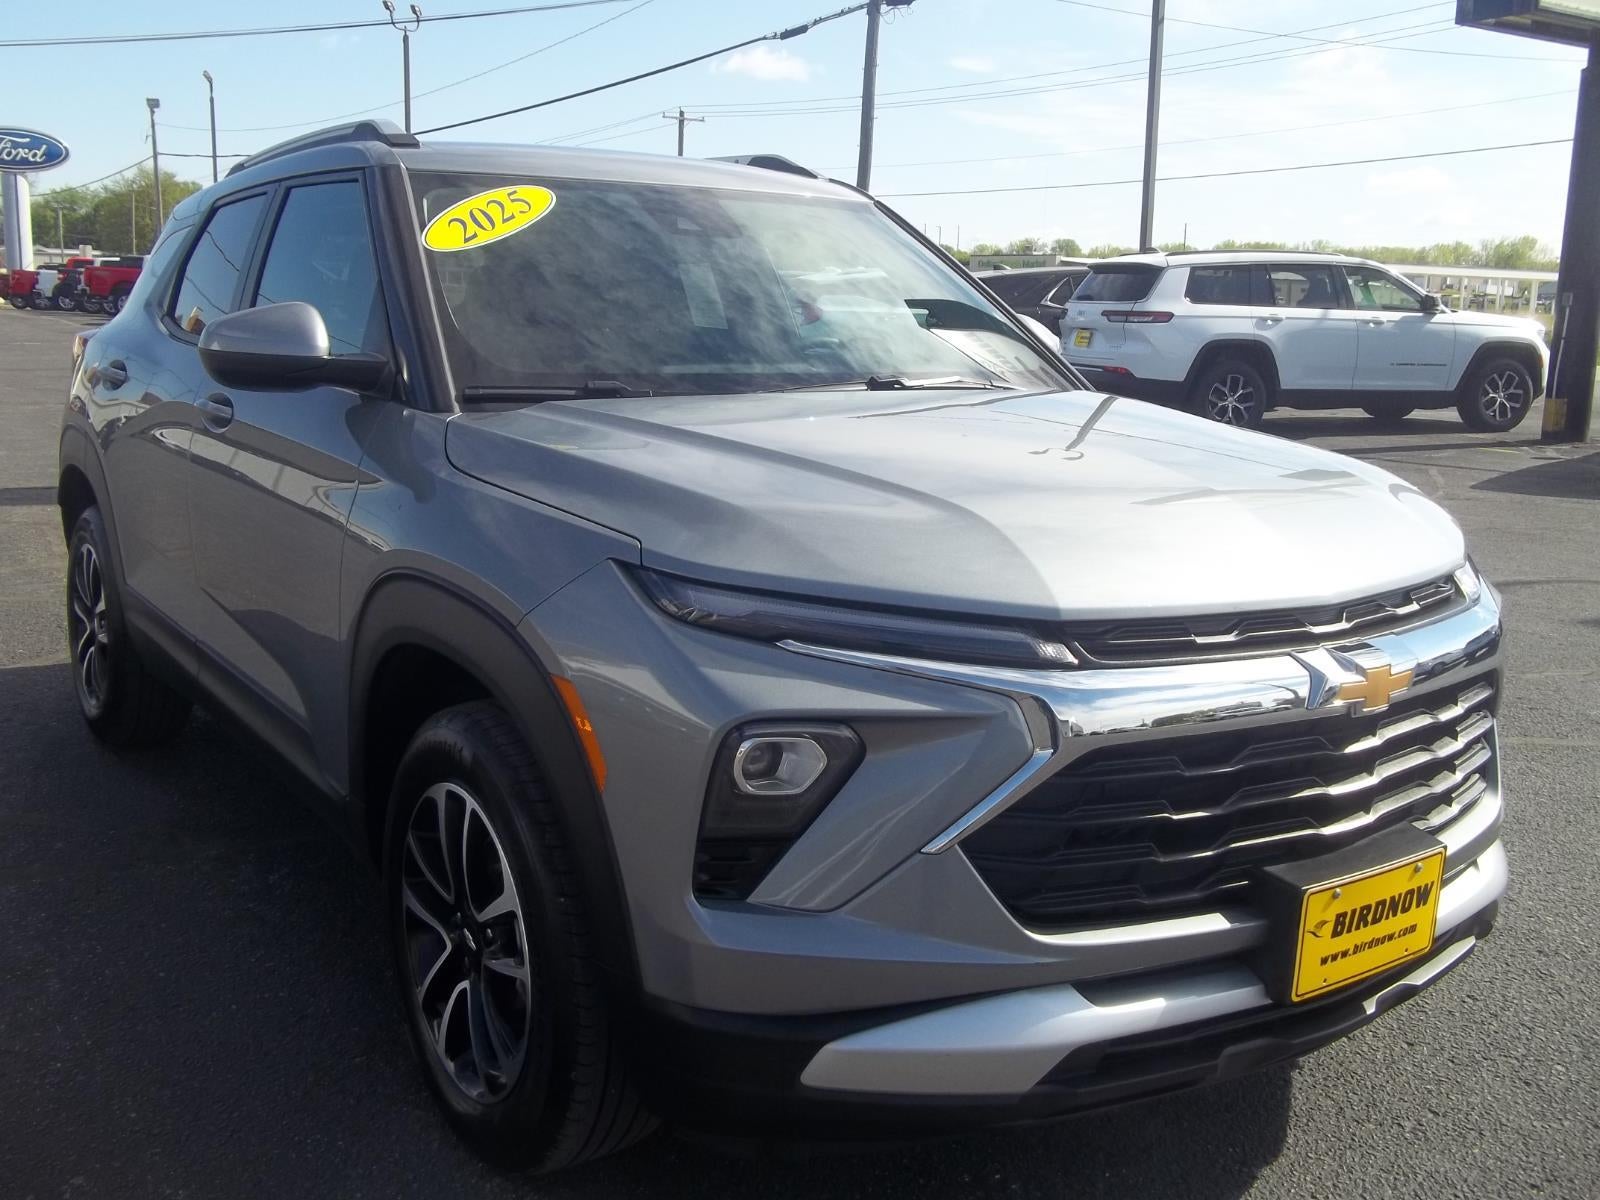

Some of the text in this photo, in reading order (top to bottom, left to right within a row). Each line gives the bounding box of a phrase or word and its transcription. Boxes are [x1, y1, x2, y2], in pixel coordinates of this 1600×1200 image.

[0, 134, 47, 162] Ford
[448, 190, 531, 244] 2025
[1330, 882, 1434, 939] BIRDNOW
[1320, 924, 1417, 966] www.birdnow.com
